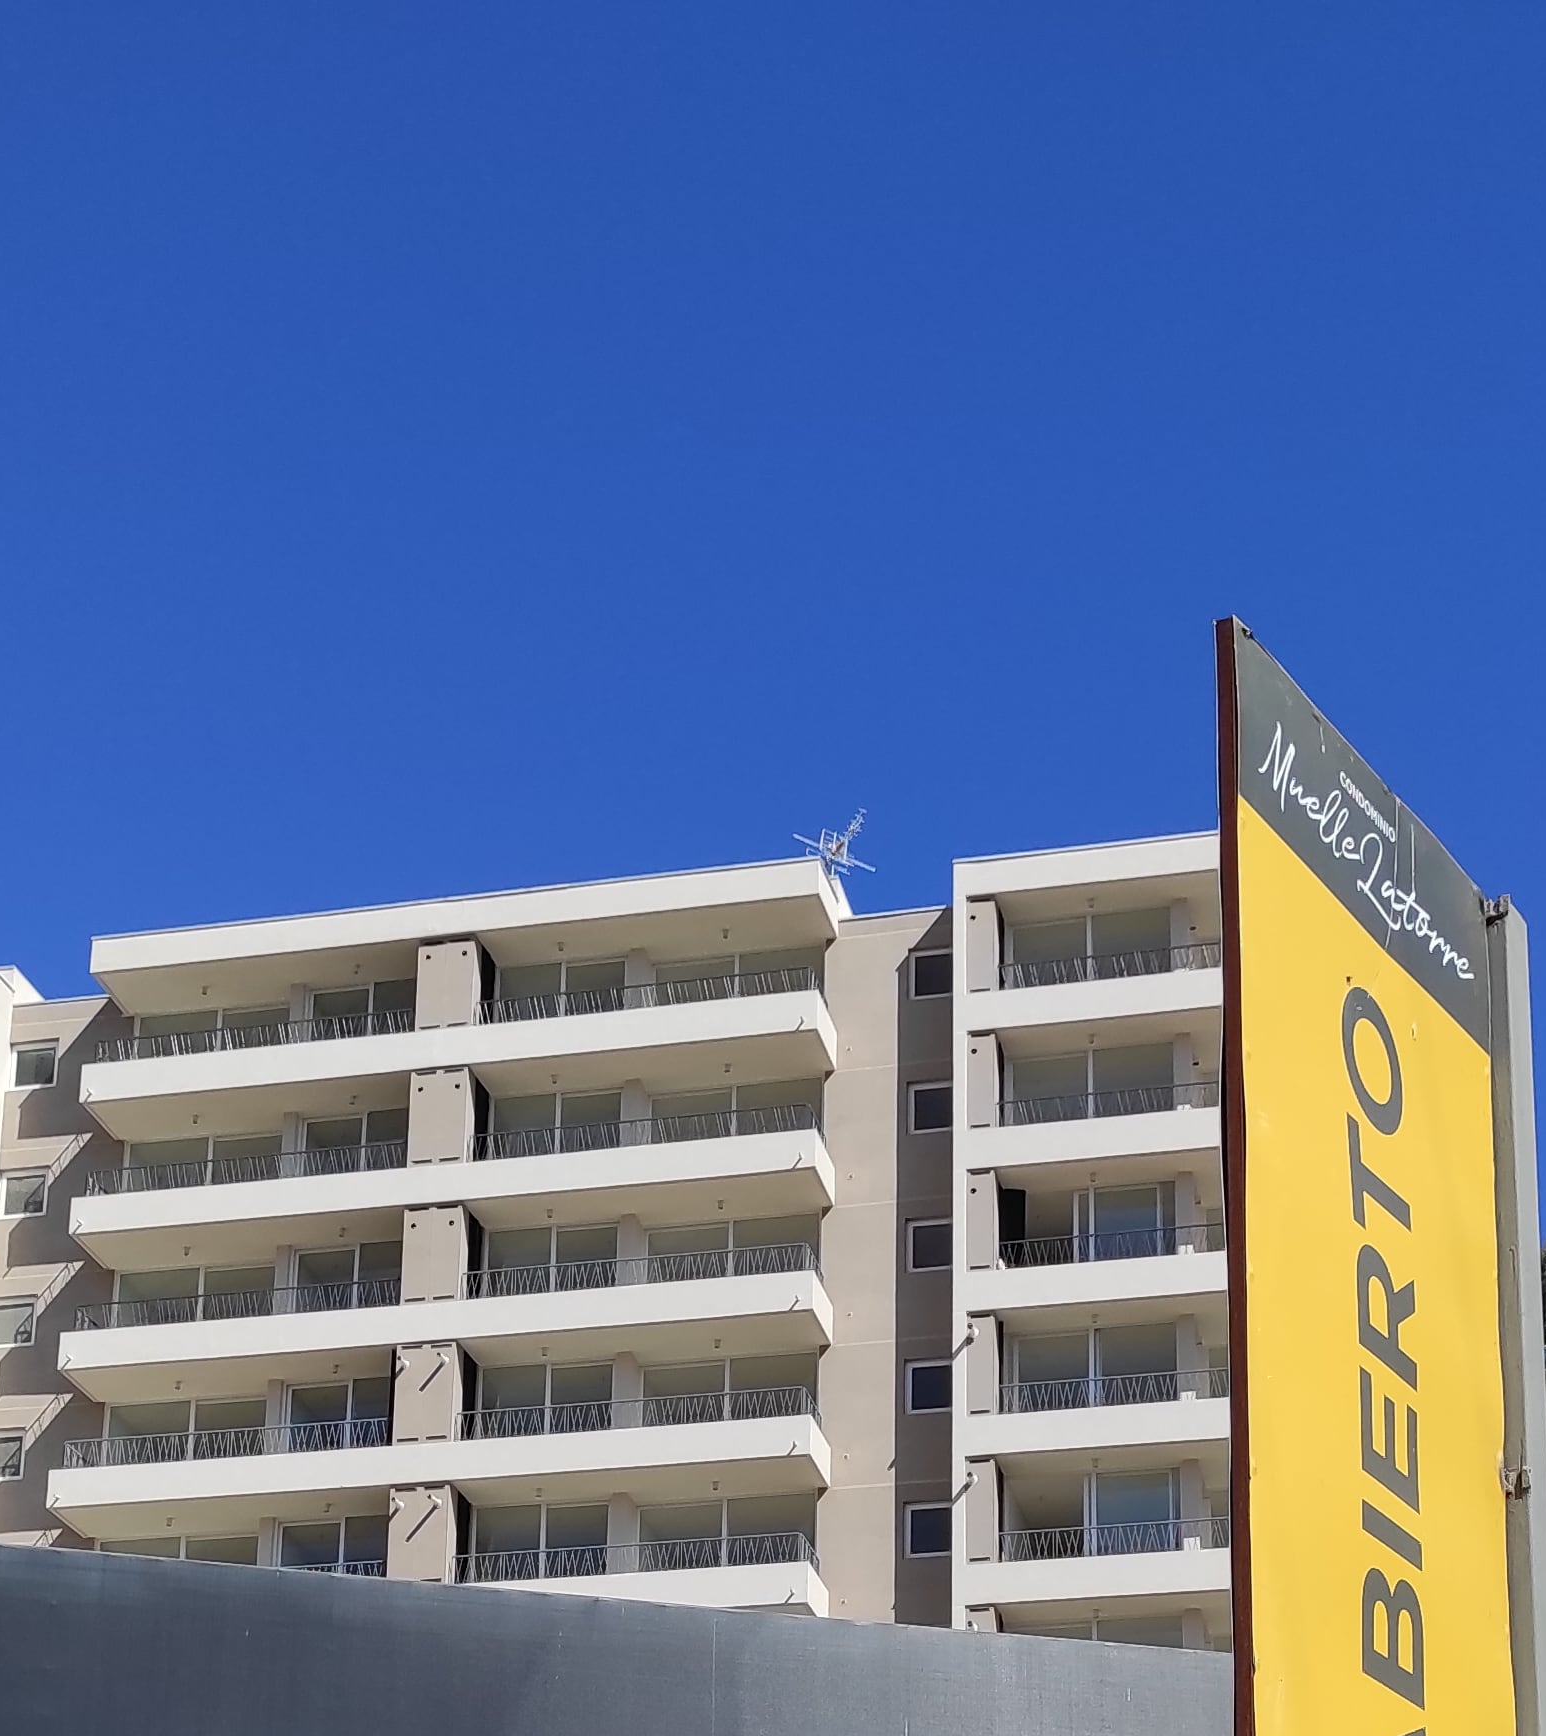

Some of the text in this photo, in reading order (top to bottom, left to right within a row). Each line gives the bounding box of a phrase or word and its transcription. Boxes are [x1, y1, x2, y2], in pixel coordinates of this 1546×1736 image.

[1258, 721, 1475, 980] Muelle Latorre
[1339, 771, 1397, 843] CONDOMINIO
